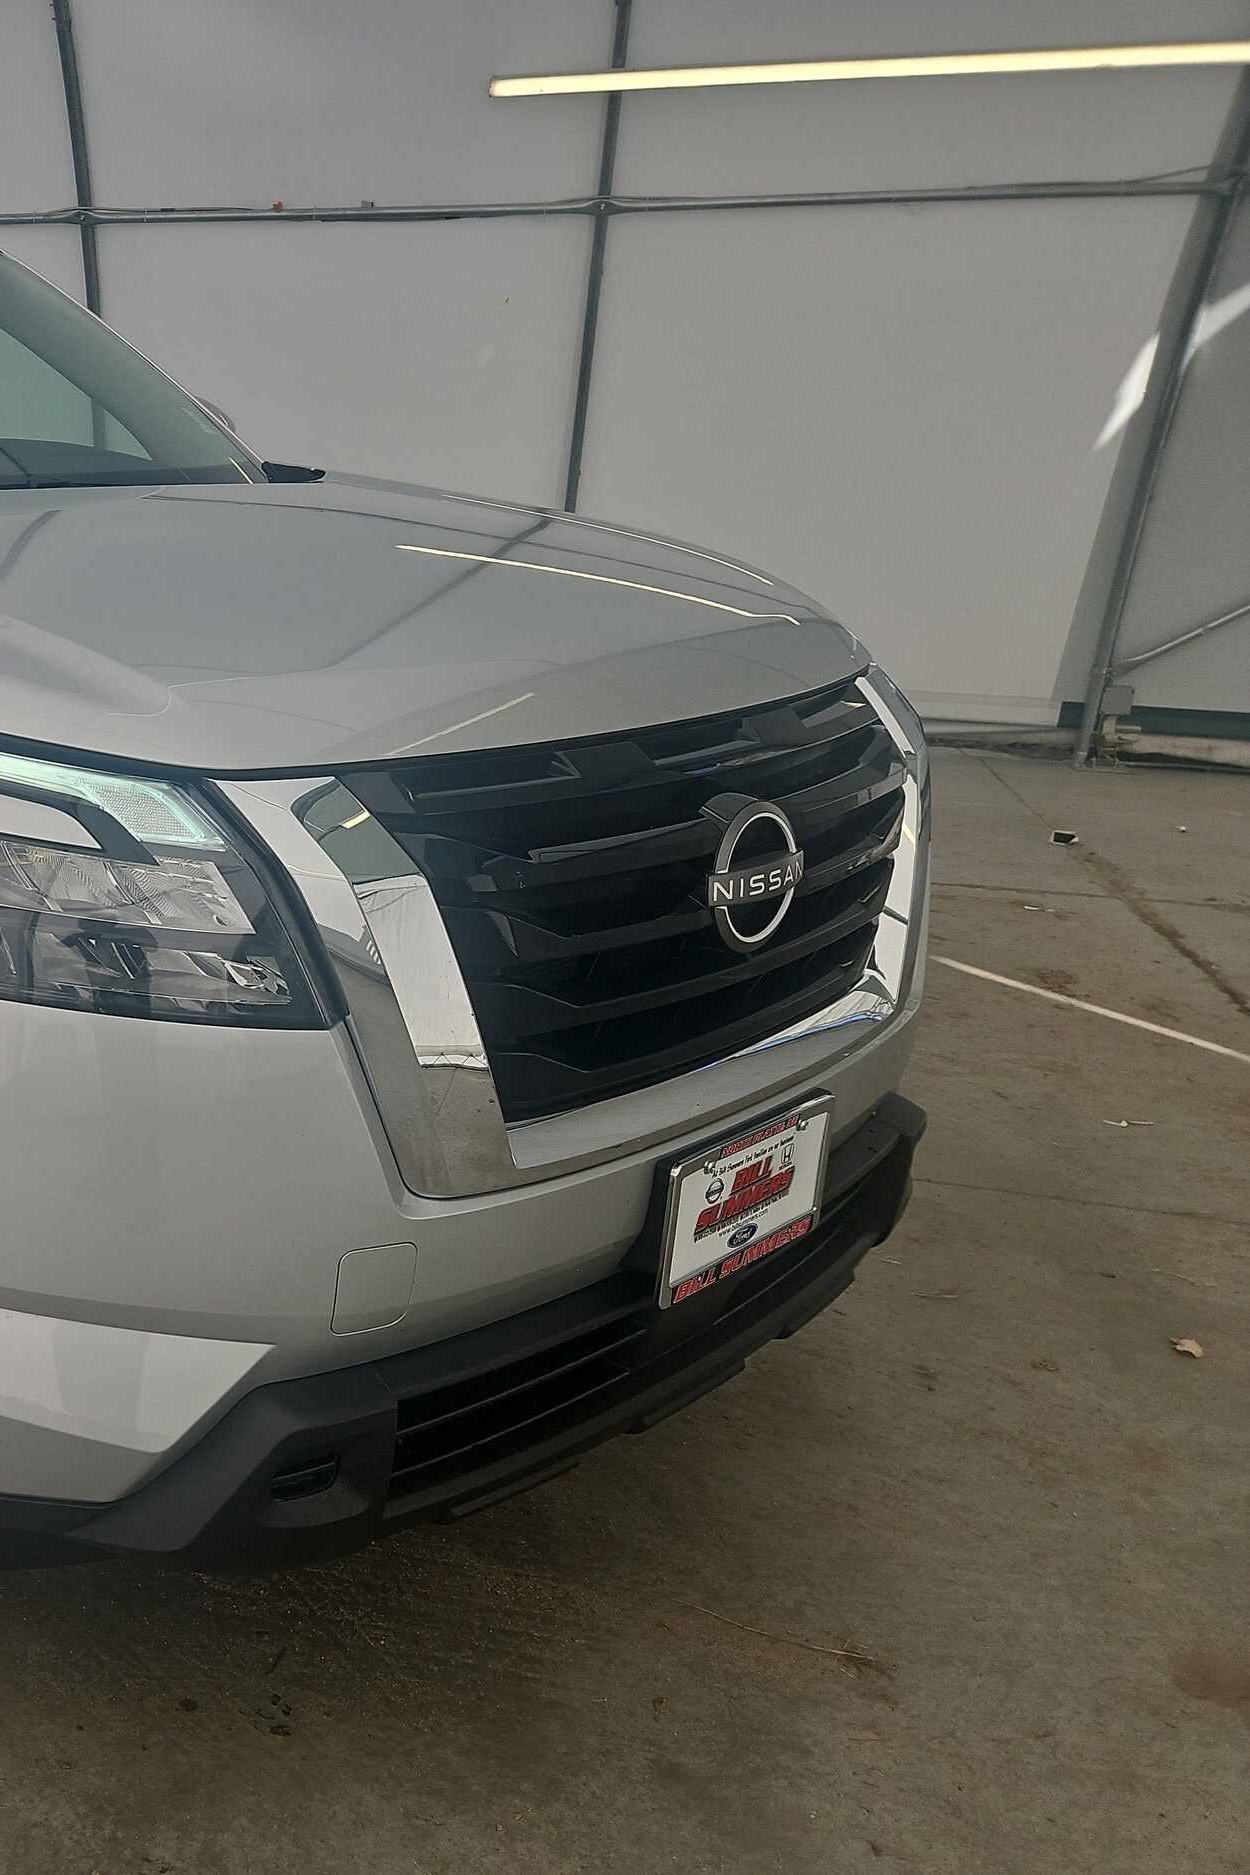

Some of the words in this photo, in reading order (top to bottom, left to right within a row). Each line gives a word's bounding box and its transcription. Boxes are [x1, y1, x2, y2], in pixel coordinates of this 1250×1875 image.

[712, 860, 803, 902] NISSAN
[694, 1165, 796, 1232] SUMMERS
[730, 1155, 774, 1192] BILL
[673, 1270, 717, 1304] BILL
[719, 1218, 813, 1278] SUMMERS
